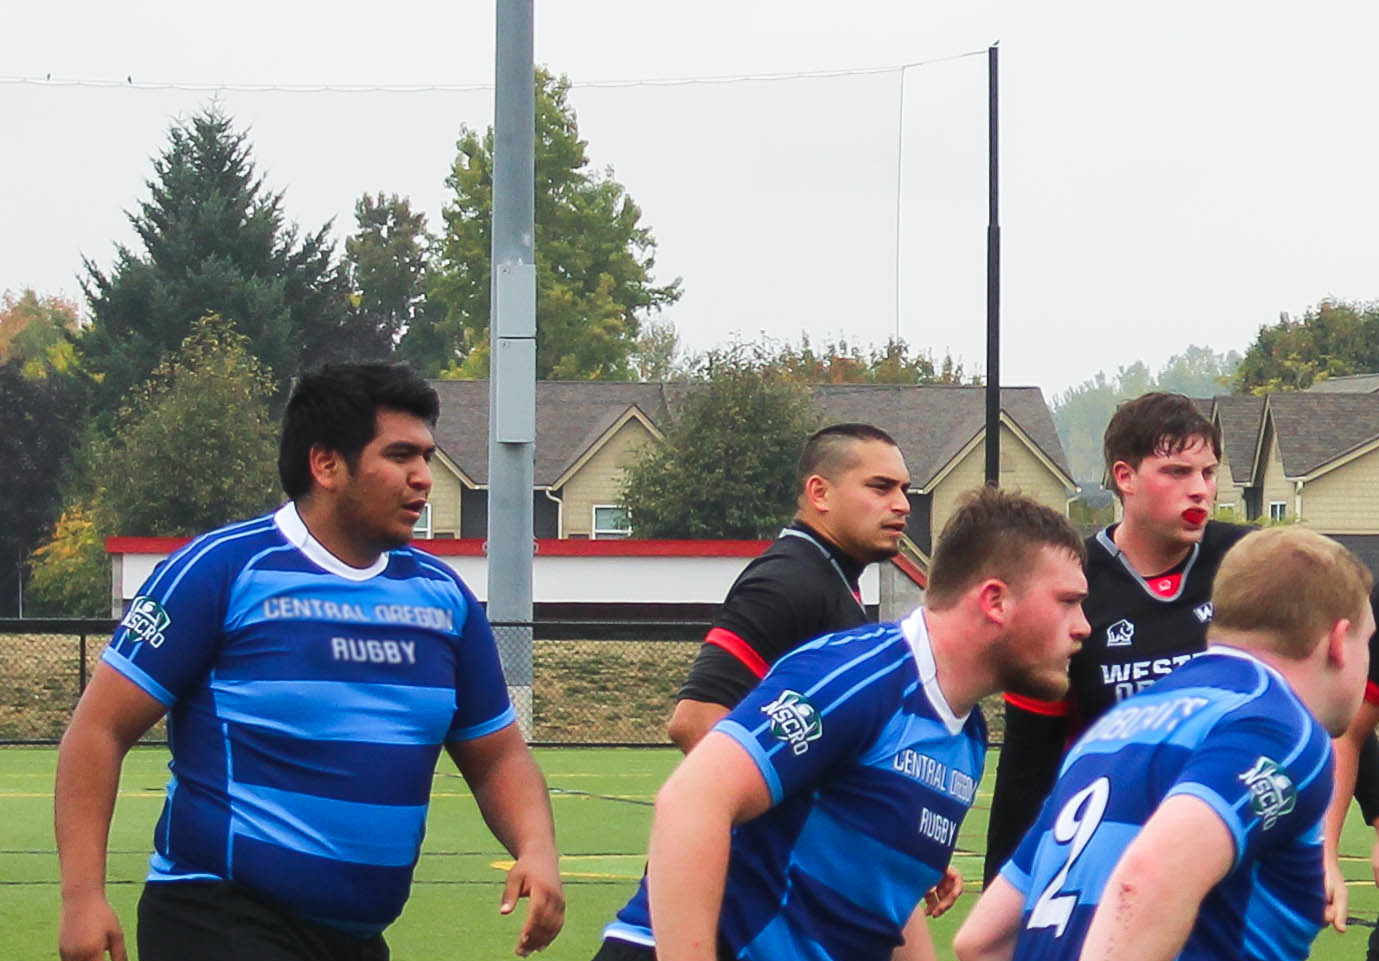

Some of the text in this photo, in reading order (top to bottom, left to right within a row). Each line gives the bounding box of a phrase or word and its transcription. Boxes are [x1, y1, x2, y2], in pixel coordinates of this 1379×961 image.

[263, 597, 454, 631] CENTRAL OREGON
[331, 637, 417, 664] RUGBY
[1100, 651, 1206, 684] WEST
[761, 700, 809, 756] NSCRO
[893, 749, 946, 791] CENTRAL
[918, 807, 957, 847] RUGBY
[1026, 776, 1110, 938] 2
